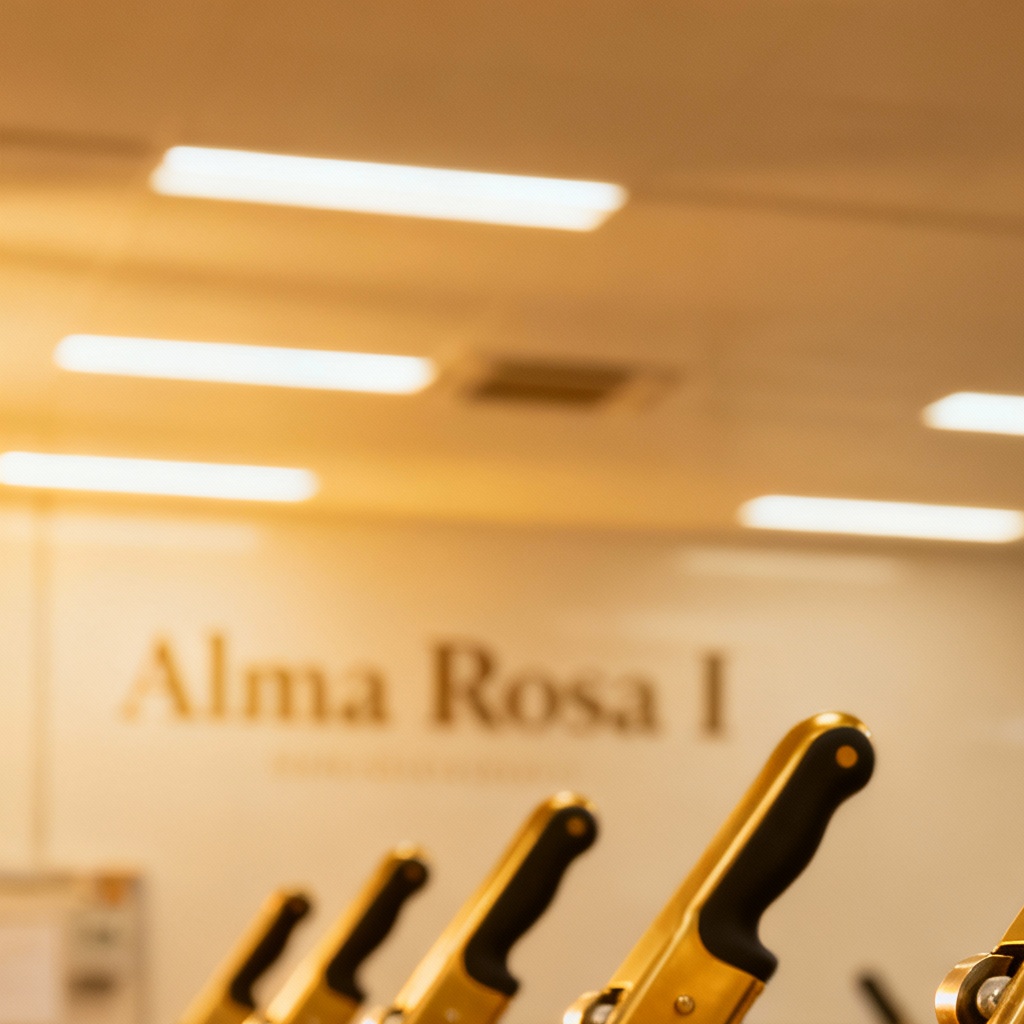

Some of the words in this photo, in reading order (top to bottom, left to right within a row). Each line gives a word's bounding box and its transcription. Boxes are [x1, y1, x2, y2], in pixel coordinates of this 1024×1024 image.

[121, 631, 391, 724] Alma
[430, 639, 659, 738] Rosa
[698, 648, 731, 738] I
